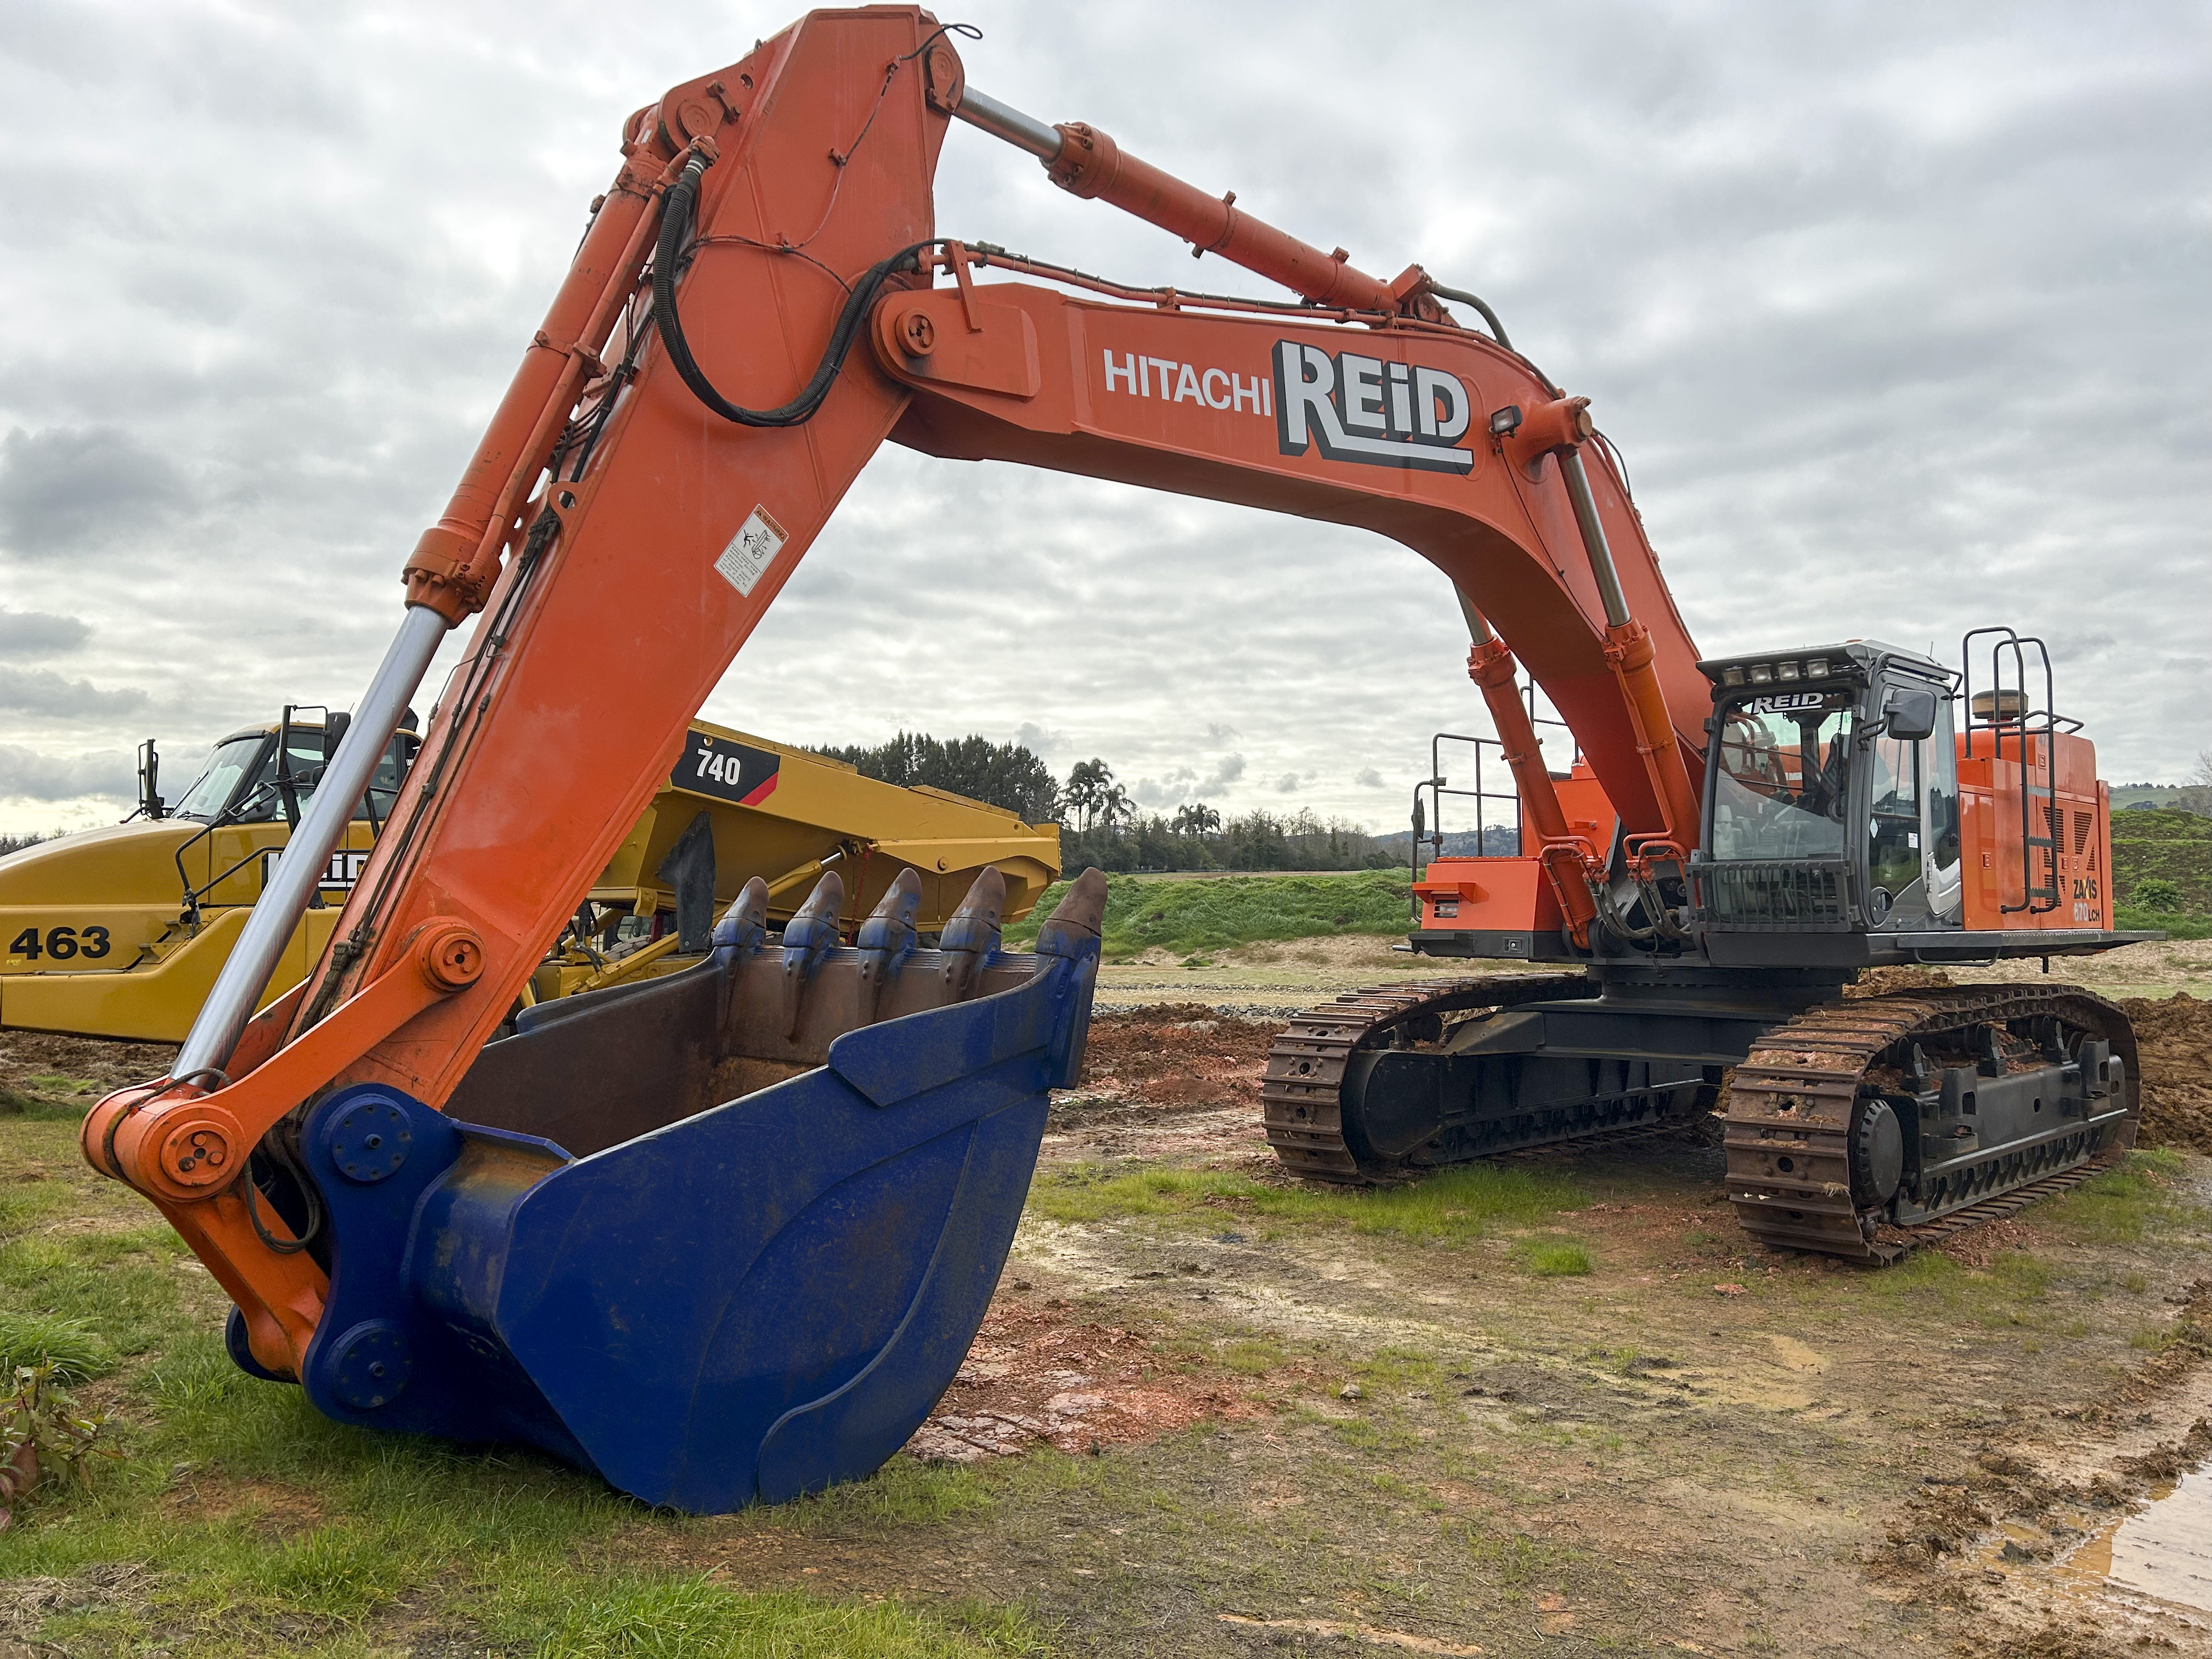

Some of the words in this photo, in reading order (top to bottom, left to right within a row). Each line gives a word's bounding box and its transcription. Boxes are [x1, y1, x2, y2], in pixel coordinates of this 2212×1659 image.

[1103, 348, 1272, 417] HITACHI
[763, 514, 785, 539] WARNING
[697, 748, 741, 785] 740
[10, 926, 110, 960] 463
